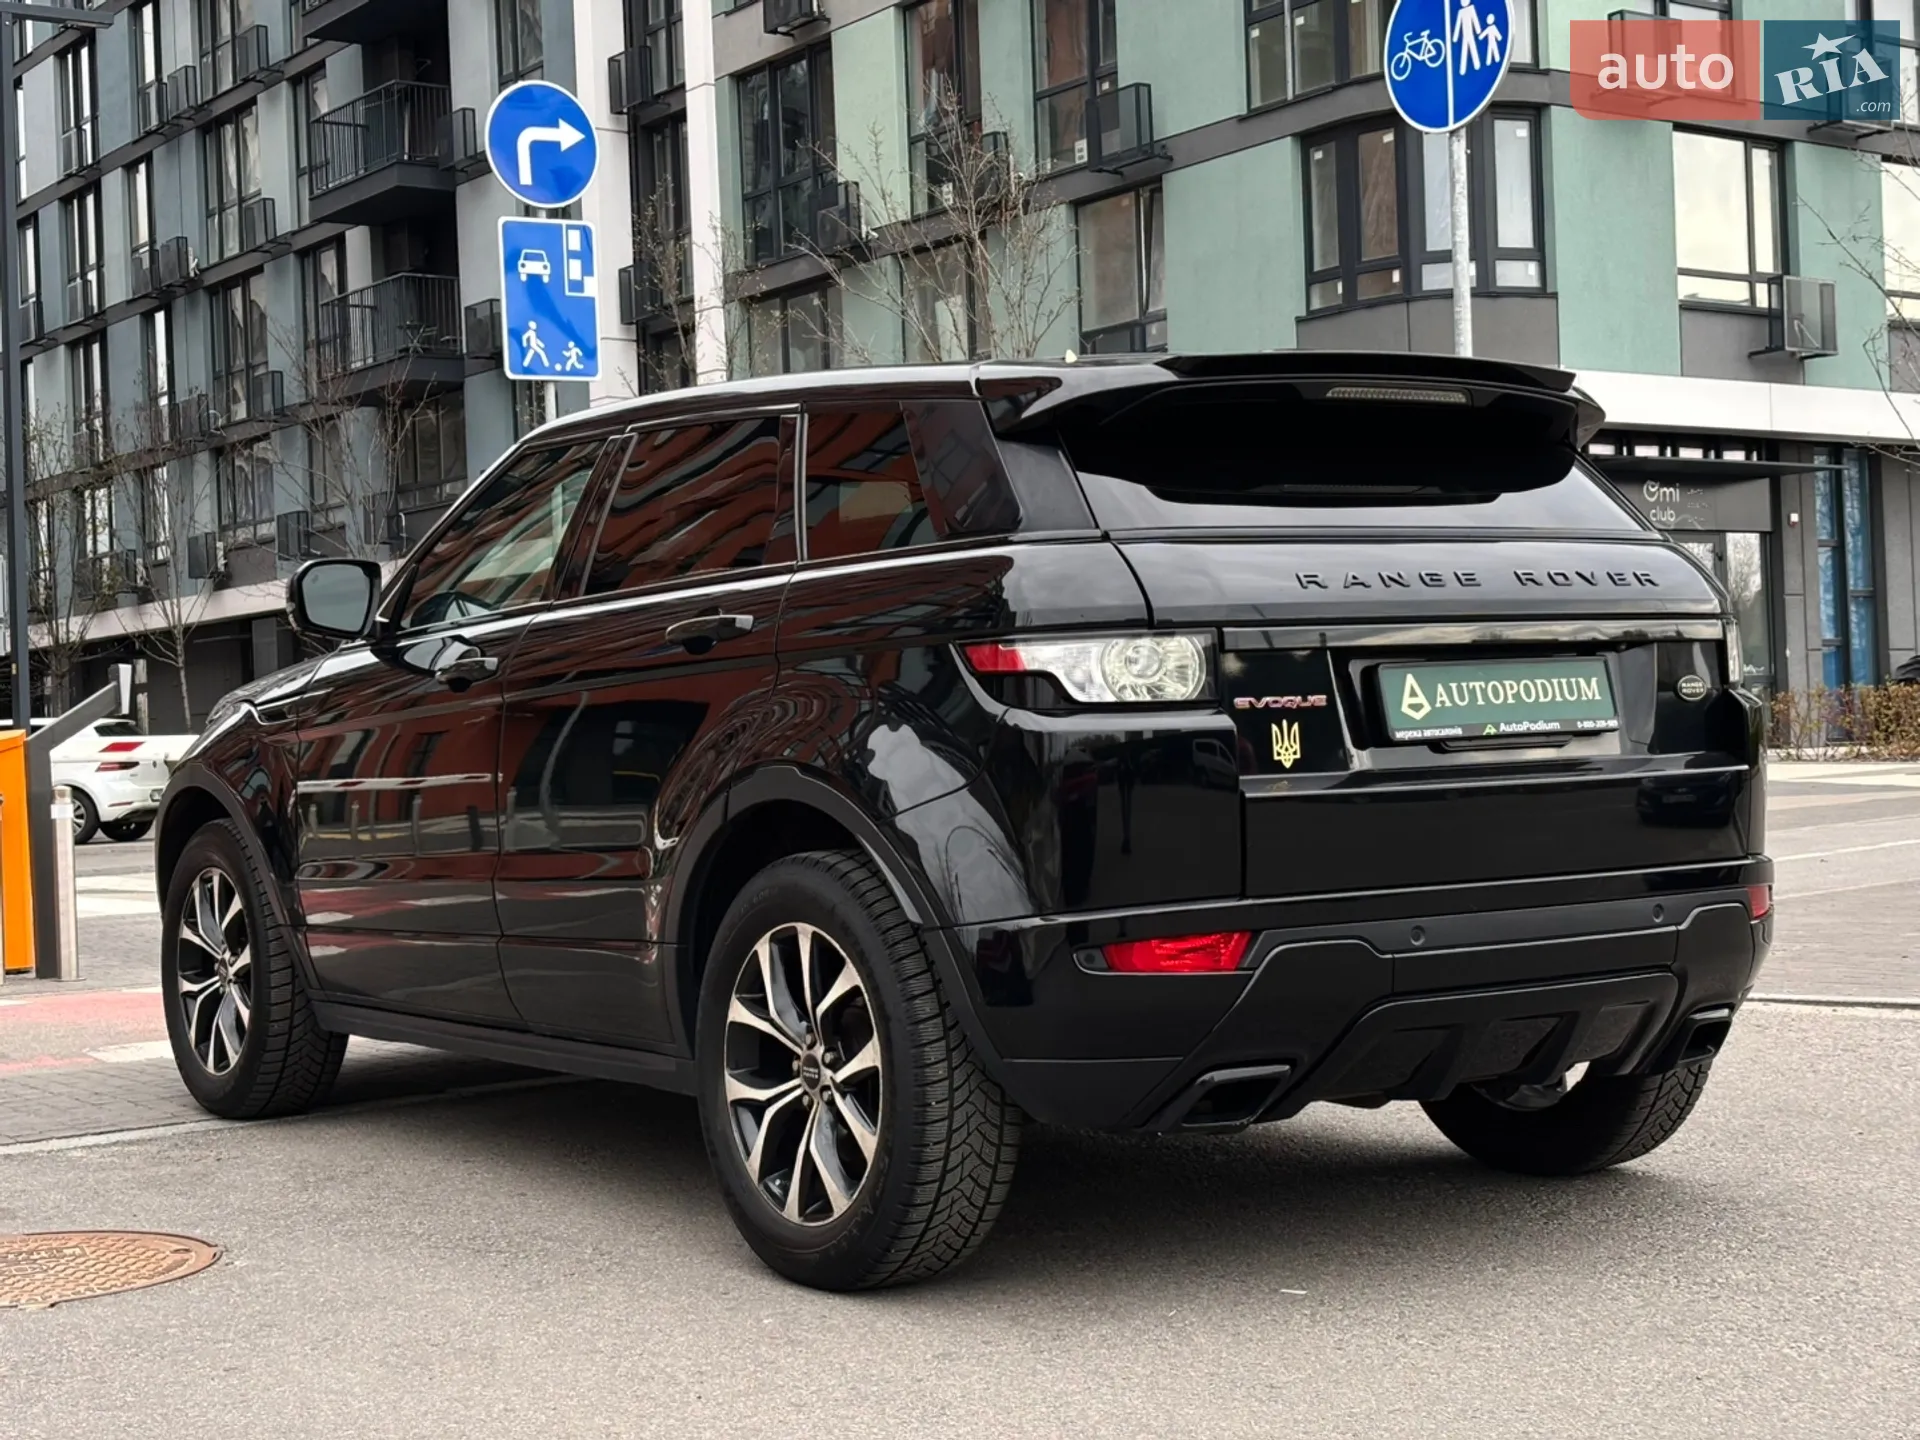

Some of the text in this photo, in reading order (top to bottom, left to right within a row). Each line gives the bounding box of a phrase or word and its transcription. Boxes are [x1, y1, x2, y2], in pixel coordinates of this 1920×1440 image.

[1650, 506, 1676, 521] club
[1295, 570, 1660, 589] RANGE ROVER
[1435, 677, 1602, 708] AUTOPODIUM
[1233, 695, 1327, 709] EVOQUE
[1500, 720, 1560, 732] AutoPodium
